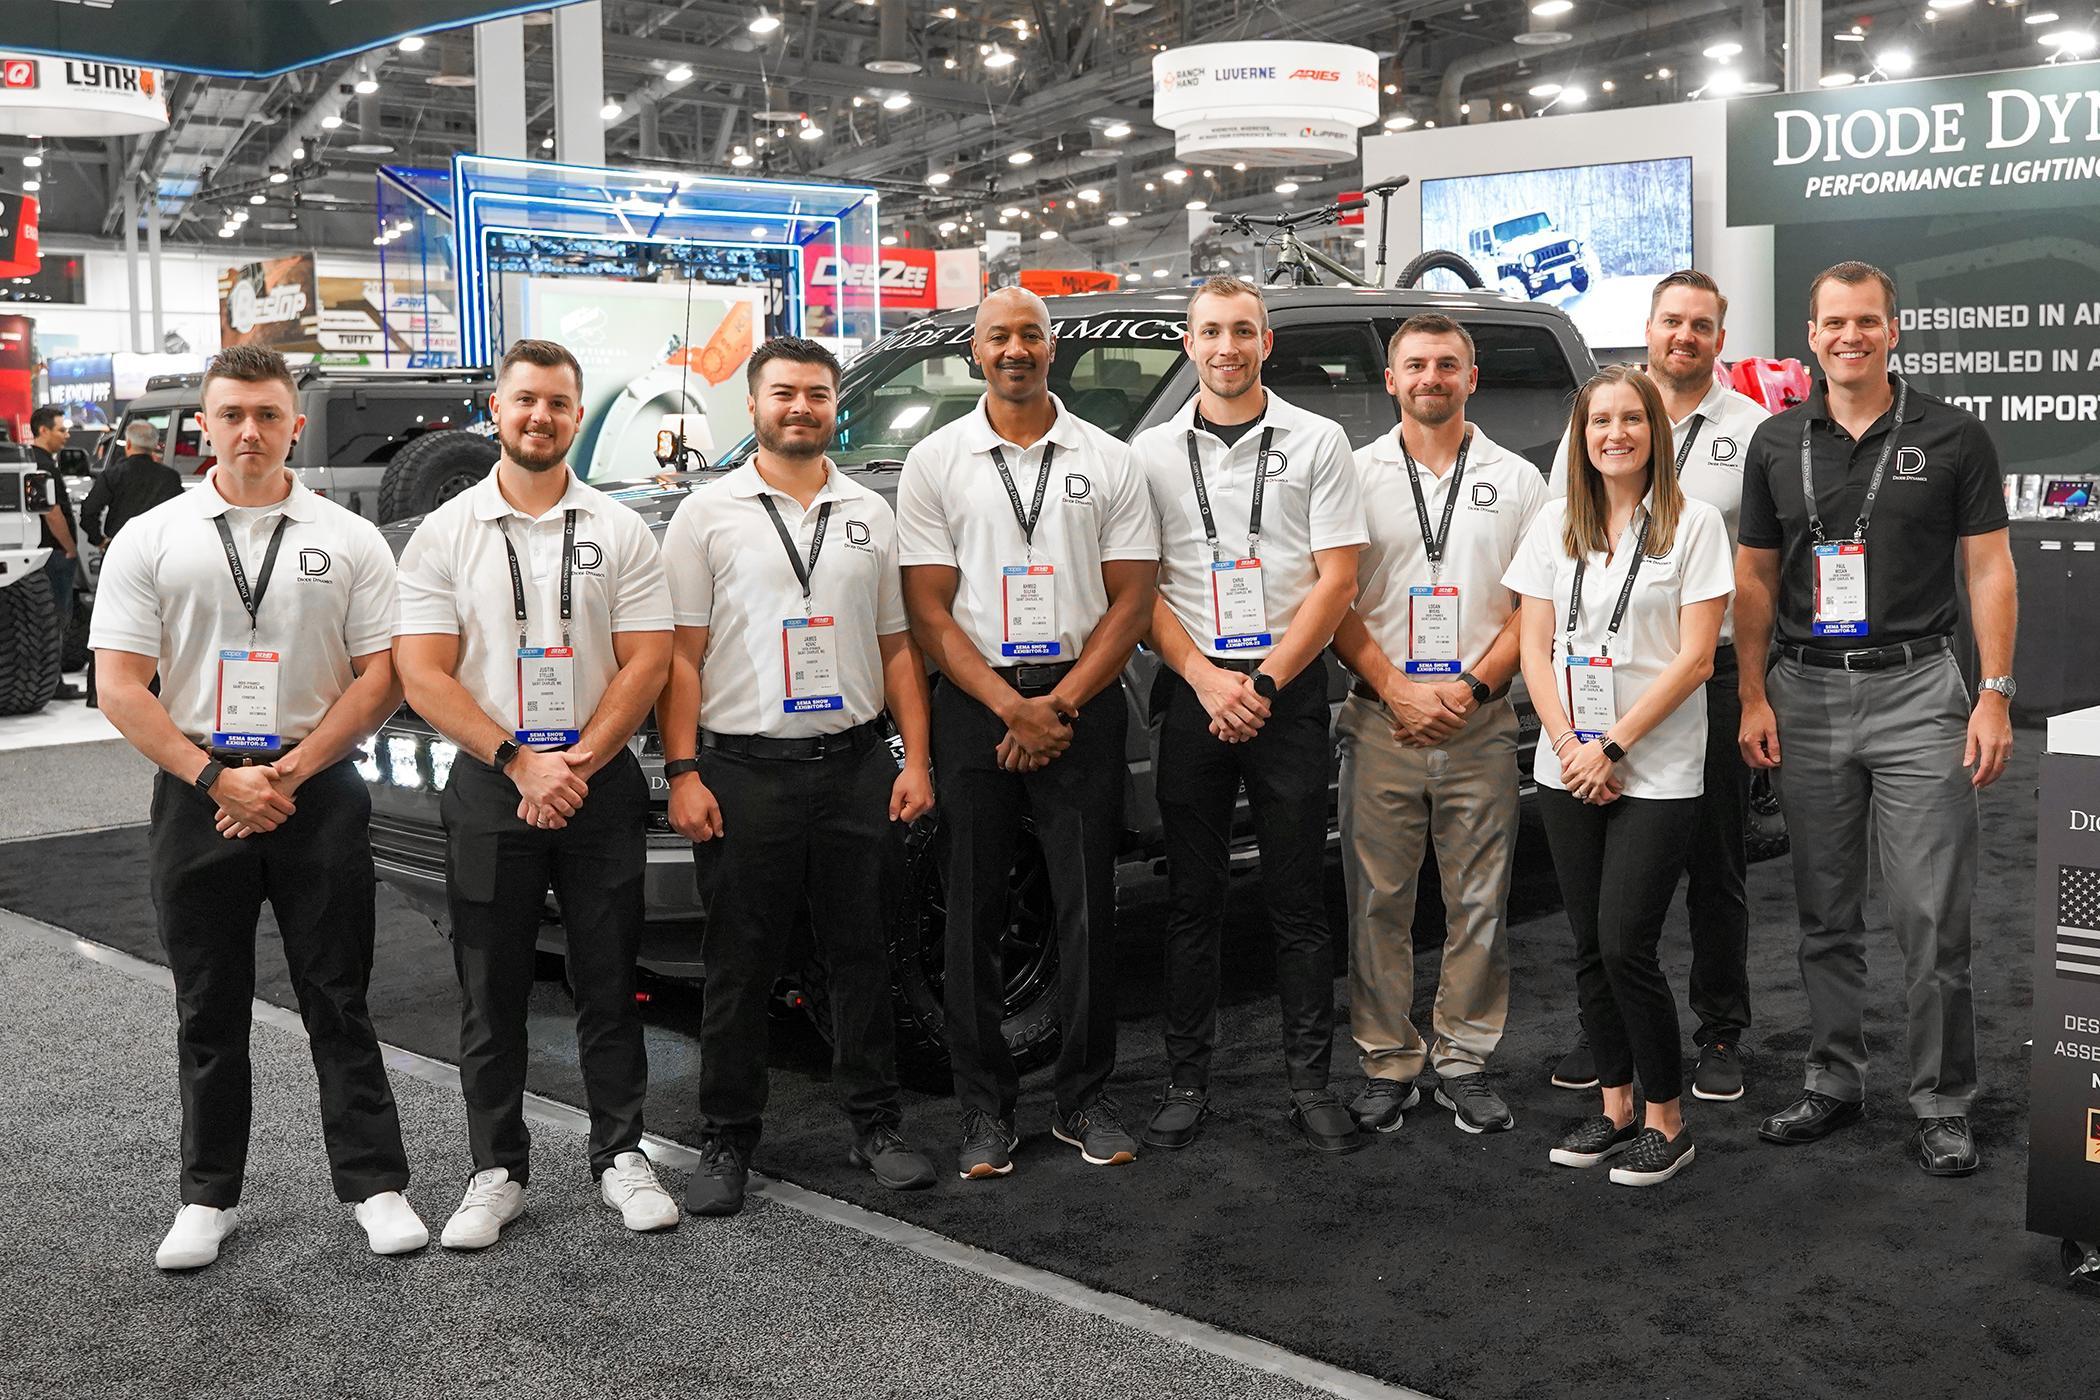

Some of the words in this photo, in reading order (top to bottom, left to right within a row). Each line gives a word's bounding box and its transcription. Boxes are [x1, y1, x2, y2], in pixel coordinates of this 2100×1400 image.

[65, 61, 138, 92] LYNX
[1177, 67, 1205, 78] RANCH
[1177, 78, 1199, 88] HAND
[1215, 66, 1276, 82] LUVERNE
[1289, 69, 1341, 82] ARIES
[1312, 130, 1348, 139] LIPPERT
[1773, 102, 1966, 166] DIODE
[1805, 163, 1985, 199] PERFORMANCE
[1900, 304, 2029, 331] DESIGNED
[2039, 304, 2065, 327] IN
[1888, 350, 2042, 375] ASSEMBLED
[2052, 349, 2078, 372] IN
[50, 385, 65, 403] WE
[66, 382, 93, 402] KNOW
[93, 382, 111, 400] PPF
[2001, 395, 2100, 421] IMPOR
[1872, 472, 1880, 490] DIODE
[1878, 446, 1891, 473] DYNAMICS
[1002, 472, 1014, 492] DIODE
[1010, 490, 1025, 524] DYNAMICS
[1033, 492, 1043, 512] DIODE
[1038, 462, 1049, 492] DYNAMICS
[226, 542, 241, 576] DYNAMICS
[238, 577, 248, 598] DIODE
[2064, 1014, 2100, 1034] DES
